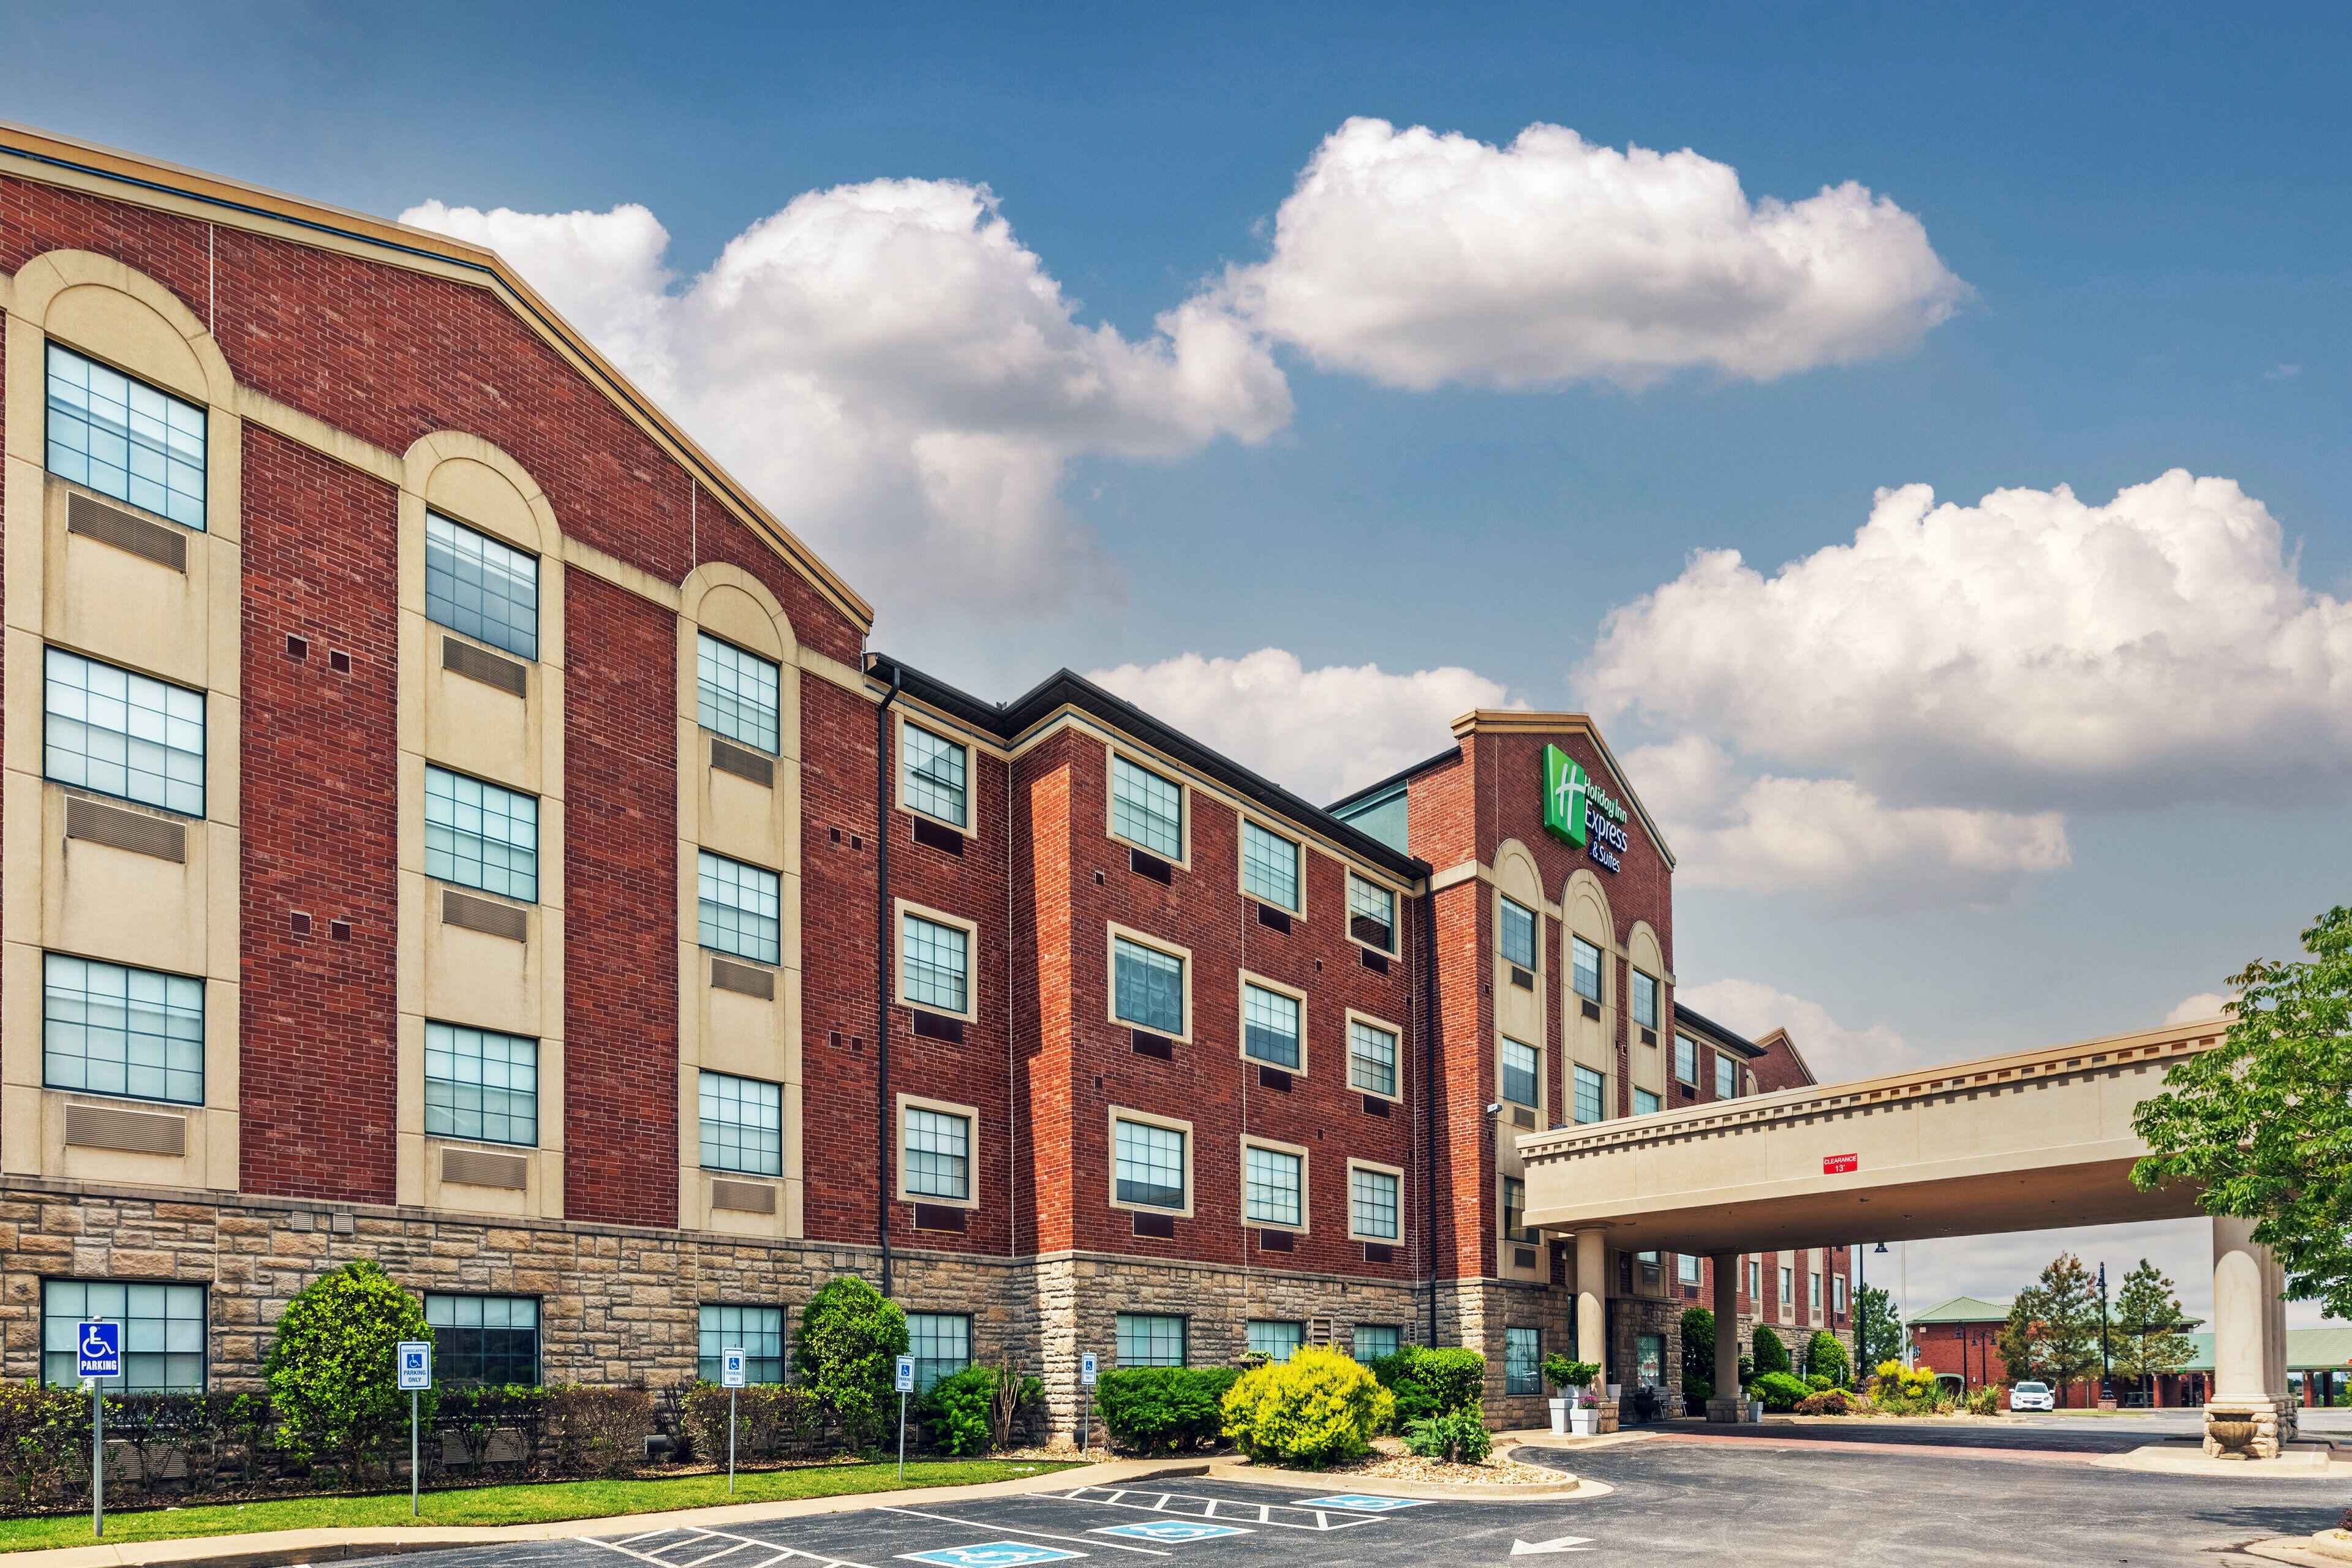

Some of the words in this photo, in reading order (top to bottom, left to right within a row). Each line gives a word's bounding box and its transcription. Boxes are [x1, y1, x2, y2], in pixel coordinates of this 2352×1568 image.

[1584, 775, 1614, 818] Holiday
[1615, 798, 1627, 824] Inn
[1585, 799, 1627, 853] Express
[1593, 841, 1598, 858] &
[1599, 846, 1620, 873] Suites
[1824, 1156, 1856, 1165] CLEARANCE
[81, 1360, 117, 1370] PARKING
